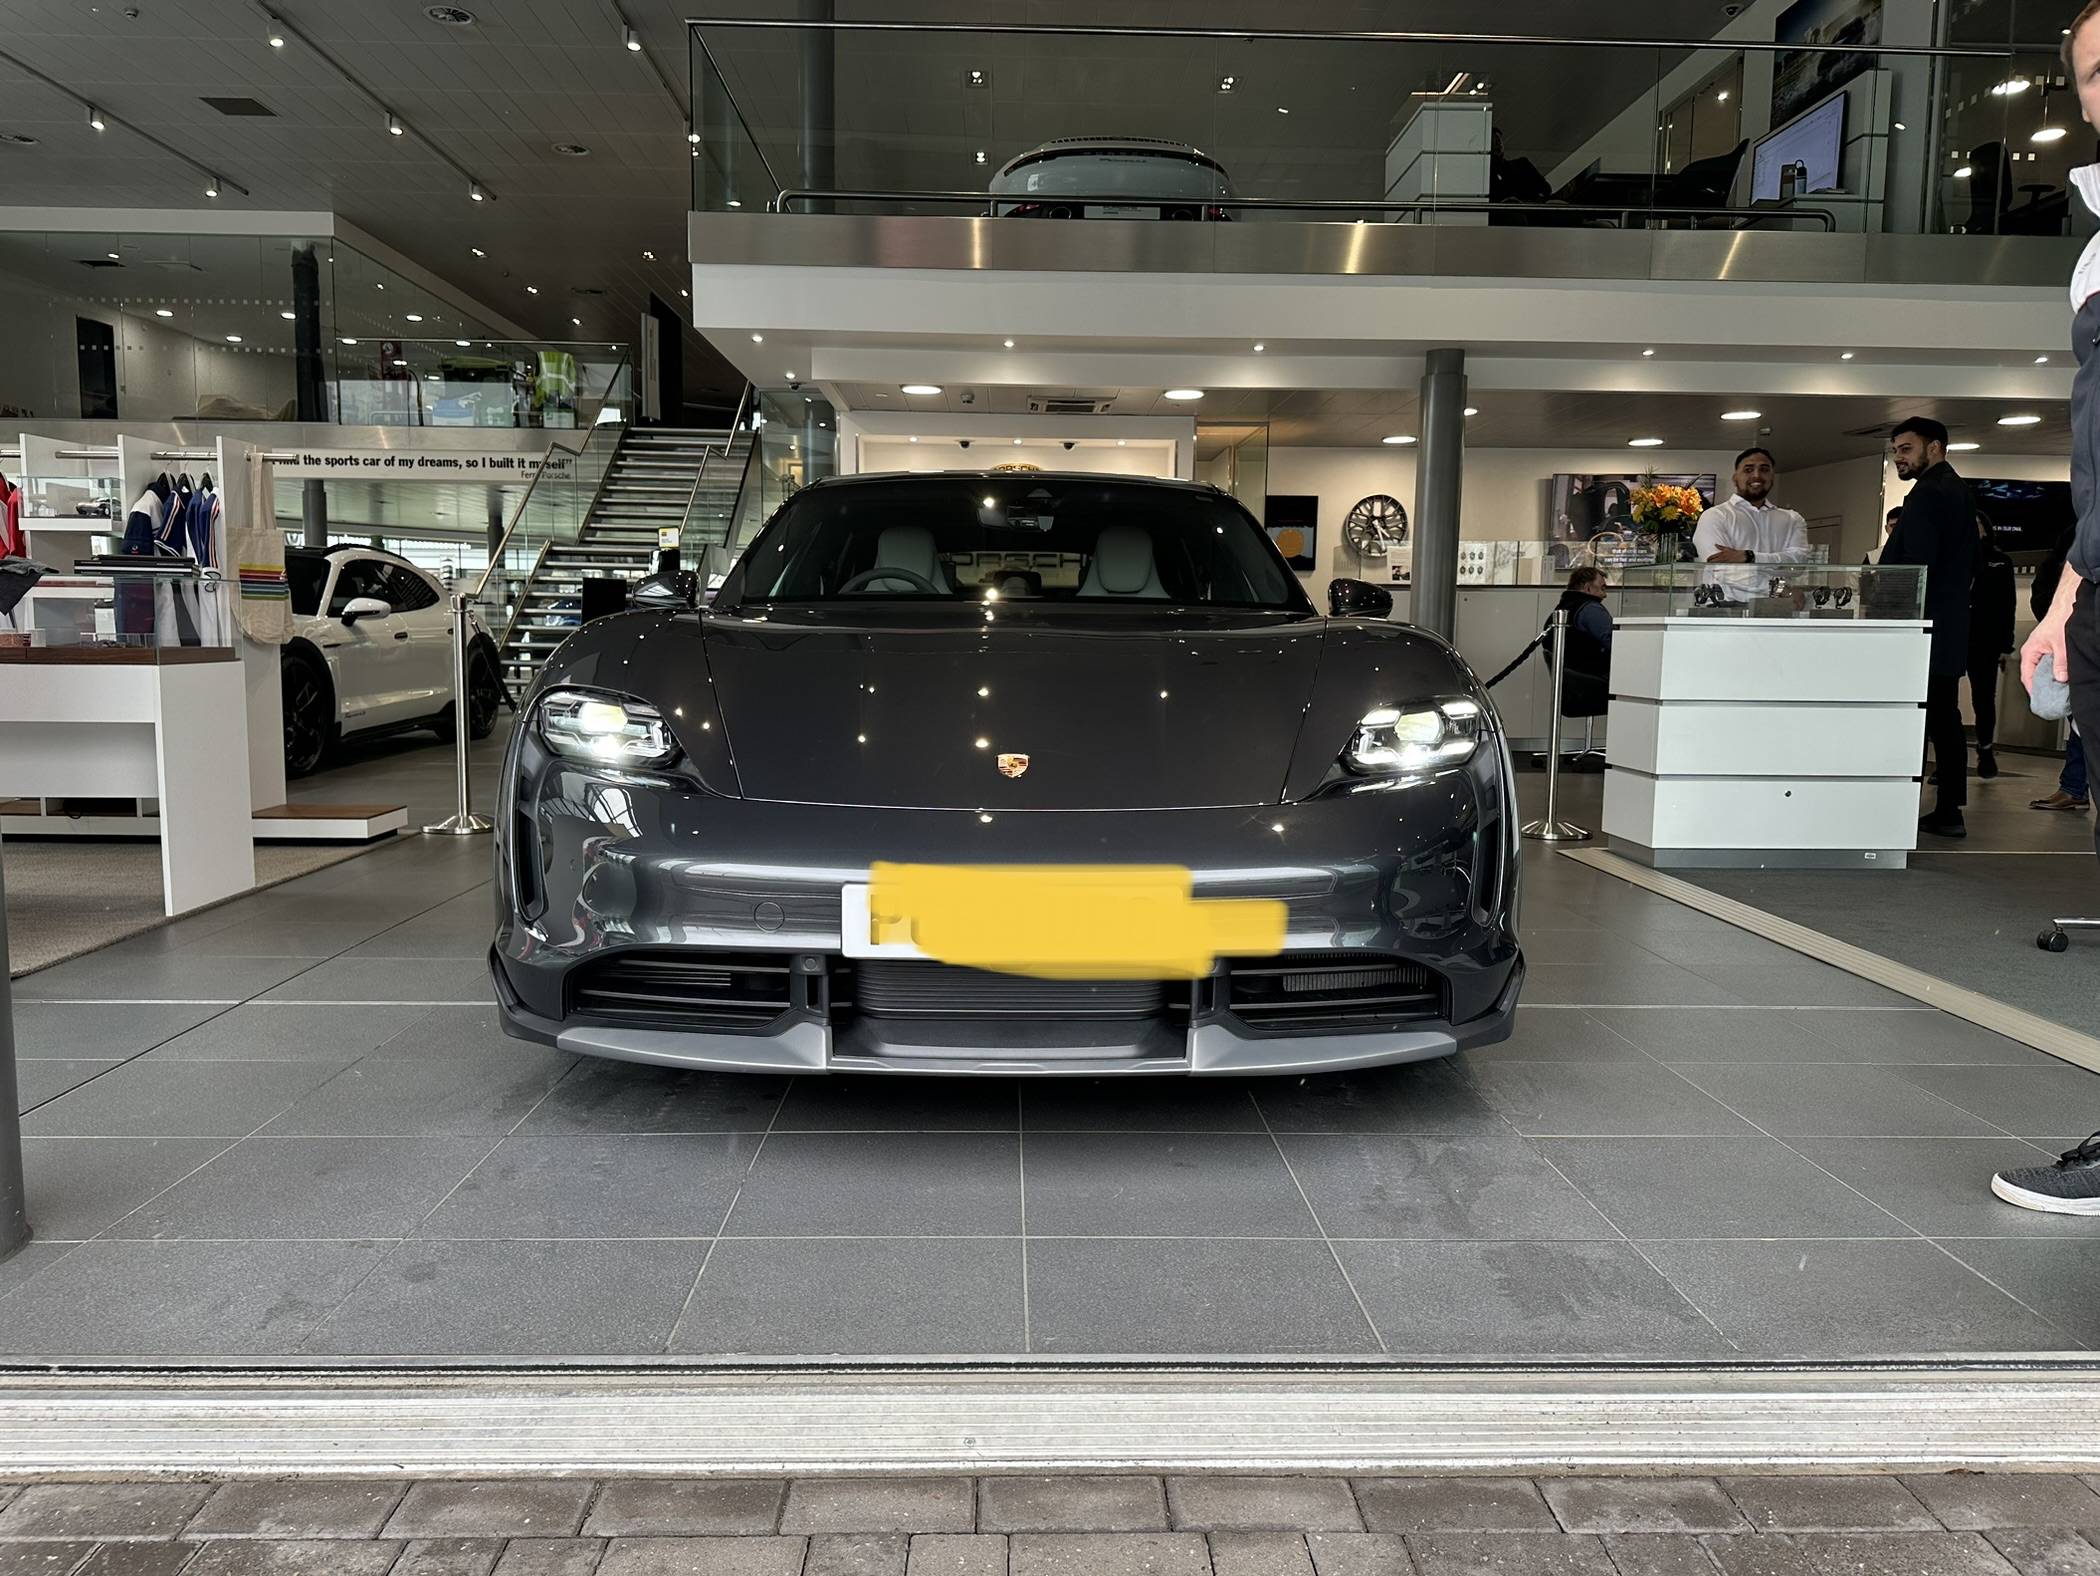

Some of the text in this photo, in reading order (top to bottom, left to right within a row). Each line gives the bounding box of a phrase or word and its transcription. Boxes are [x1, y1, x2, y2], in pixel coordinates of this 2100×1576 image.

[302, 454, 322, 466] the
[324, 455, 360, 468] sports
[362, 457, 382, 467] car
[384, 456, 397, 467] of
[398, 458, 415, 469] my
[417, 456, 463, 470] dreams,
[465, 459, 479, 468] so
[482, 457, 486, 468] I
[489, 457, 514, 469] built
[517, 457, 526, 469] it
[521, 470, 540, 480] Ferr
